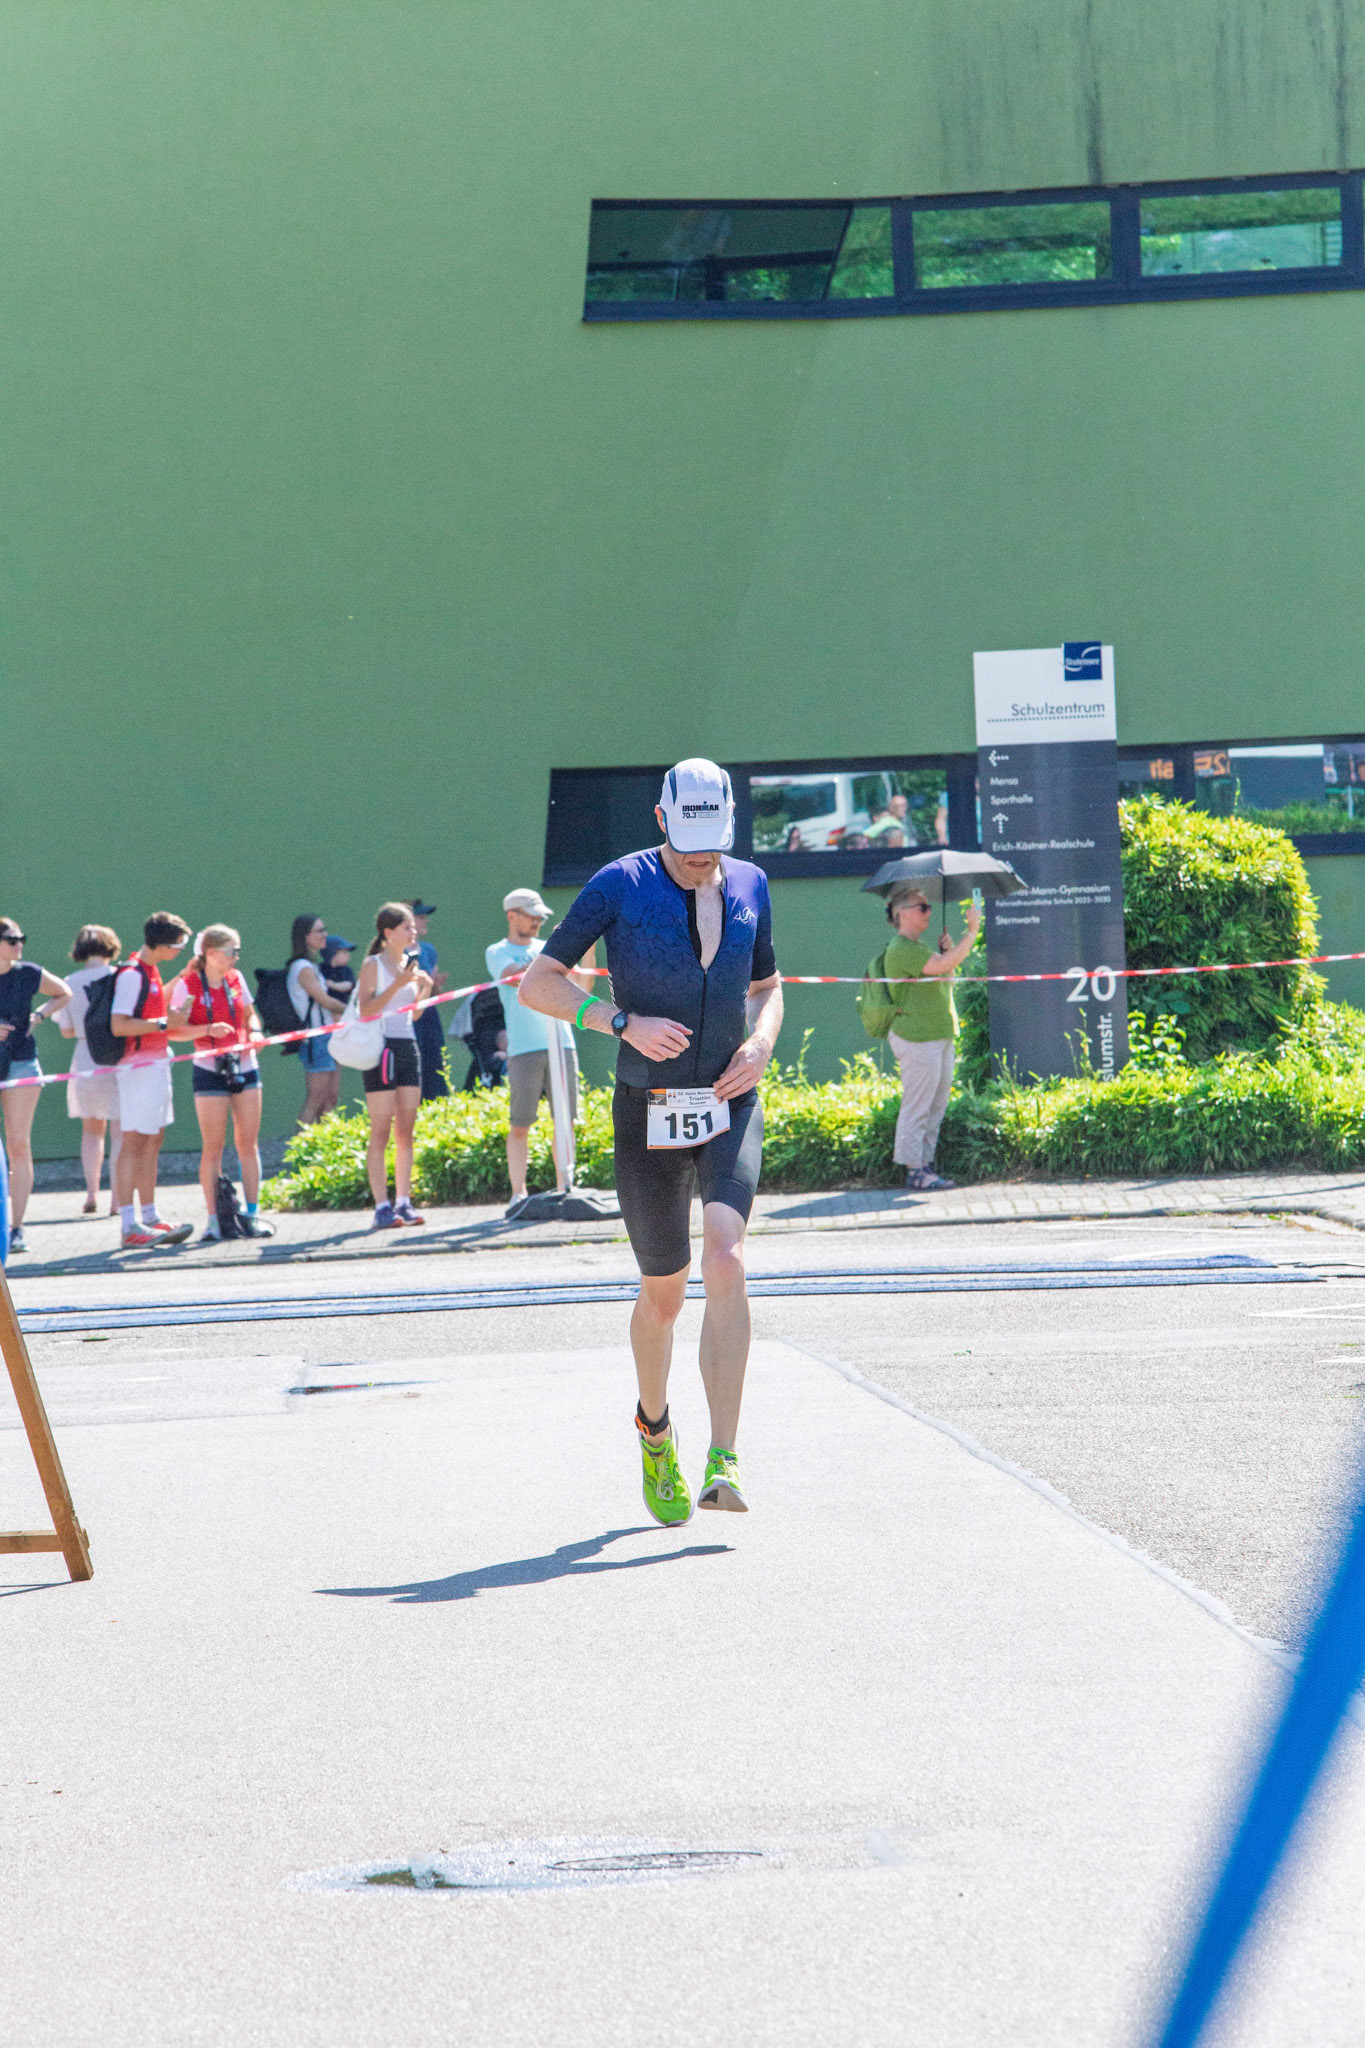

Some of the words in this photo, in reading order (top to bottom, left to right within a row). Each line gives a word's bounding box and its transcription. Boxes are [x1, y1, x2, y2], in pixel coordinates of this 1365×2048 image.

[1011, 702, 1105, 716] Schulzentrum
[990, 777, 1019, 786] Mensa
[682, 801, 719, 811] IRONMAN
[990, 794, 1034, 806] Sporthalle
[992, 838, 1095, 852] Erich-Kästner-Realschule
[1010, 884, 1110, 897] mas-Mann-Gymnasium
[995, 915, 1041, 926] Sternwarte
[1066, 965, 1116, 1002] 20
[1097, 1012, 1114, 1082] siumstr.
[665, 1111, 713, 1140] 151
